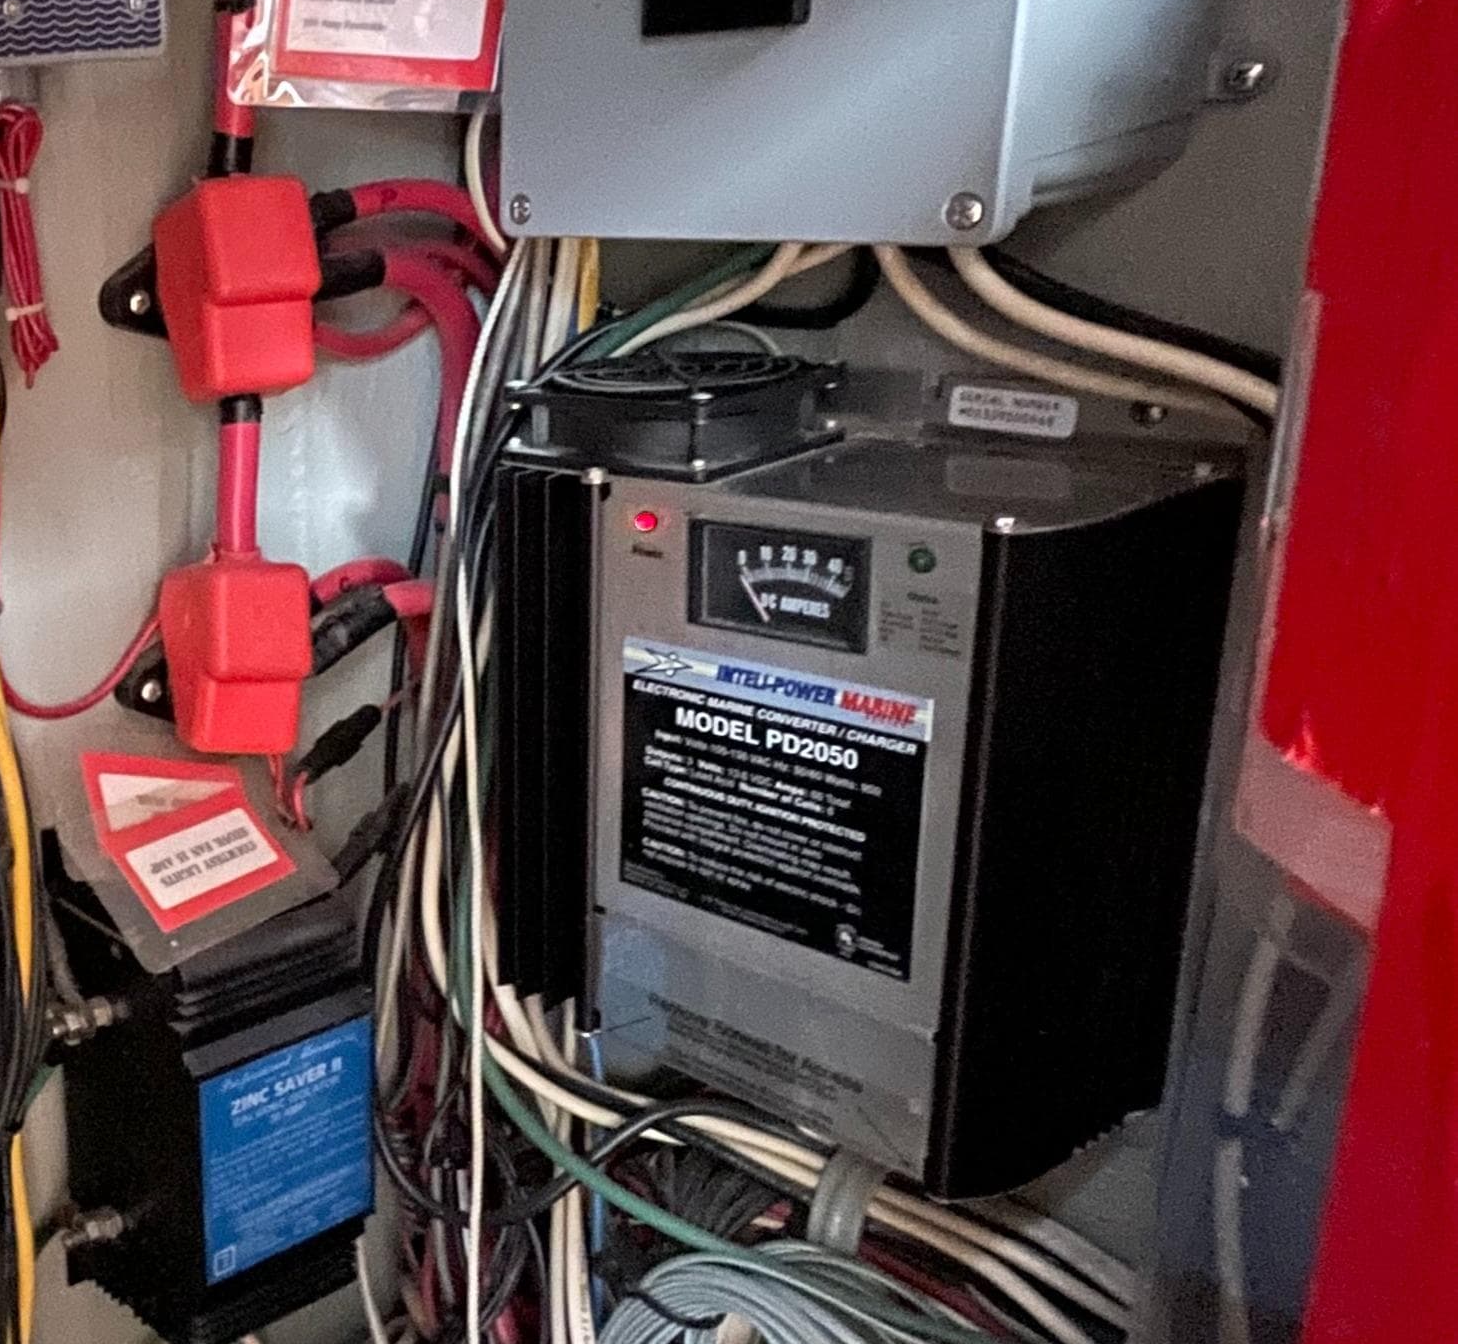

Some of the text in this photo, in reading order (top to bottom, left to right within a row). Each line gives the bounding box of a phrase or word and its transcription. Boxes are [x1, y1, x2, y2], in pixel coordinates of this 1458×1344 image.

[633, 679, 706, 706] ELECTRONIC
[706, 695, 756, 717] MARINE
[757, 706, 840, 738] CONVERTER
[846, 729, 919, 756] CHARGER
[838, 690, 919, 725] MARINE
[675, 707, 760, 746] MODEL
[765, 727, 859, 770] PD2050
[230, 1086, 271, 1116] ZINC
[273, 1062, 327, 1097] SAVER
